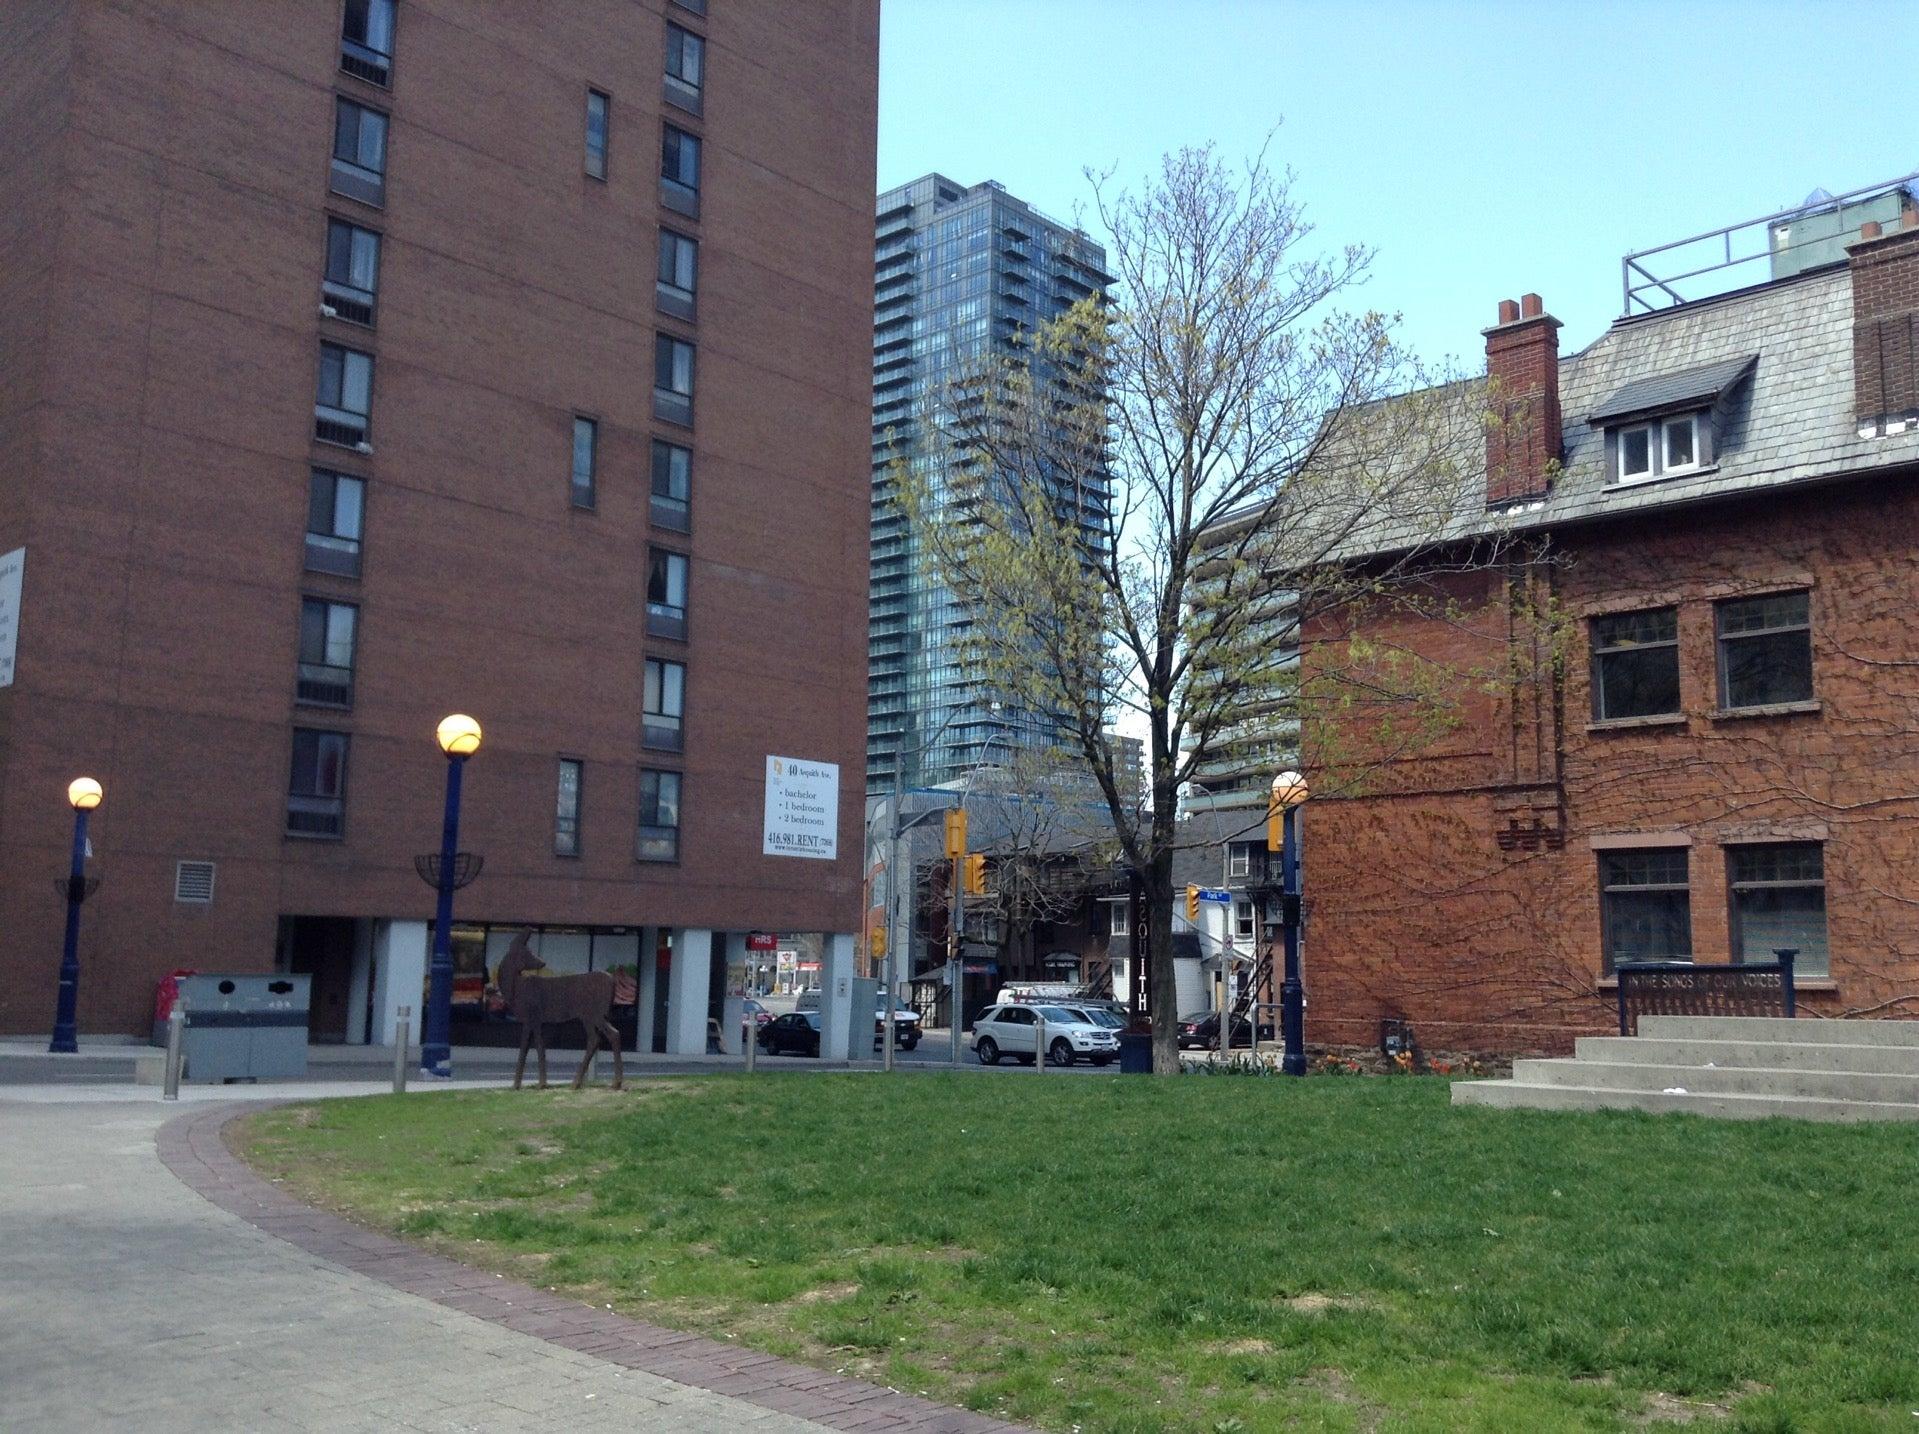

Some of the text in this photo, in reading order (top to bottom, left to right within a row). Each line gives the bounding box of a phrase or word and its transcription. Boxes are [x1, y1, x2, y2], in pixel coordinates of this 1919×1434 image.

[784, 788, 816, 799] bachelor
[791, 801, 824, 813] bedroom
[791, 814, 824, 826] bedroom
[1661, 974, 1694, 989] SONGS
[1741, 973, 1782, 988] VOICES
